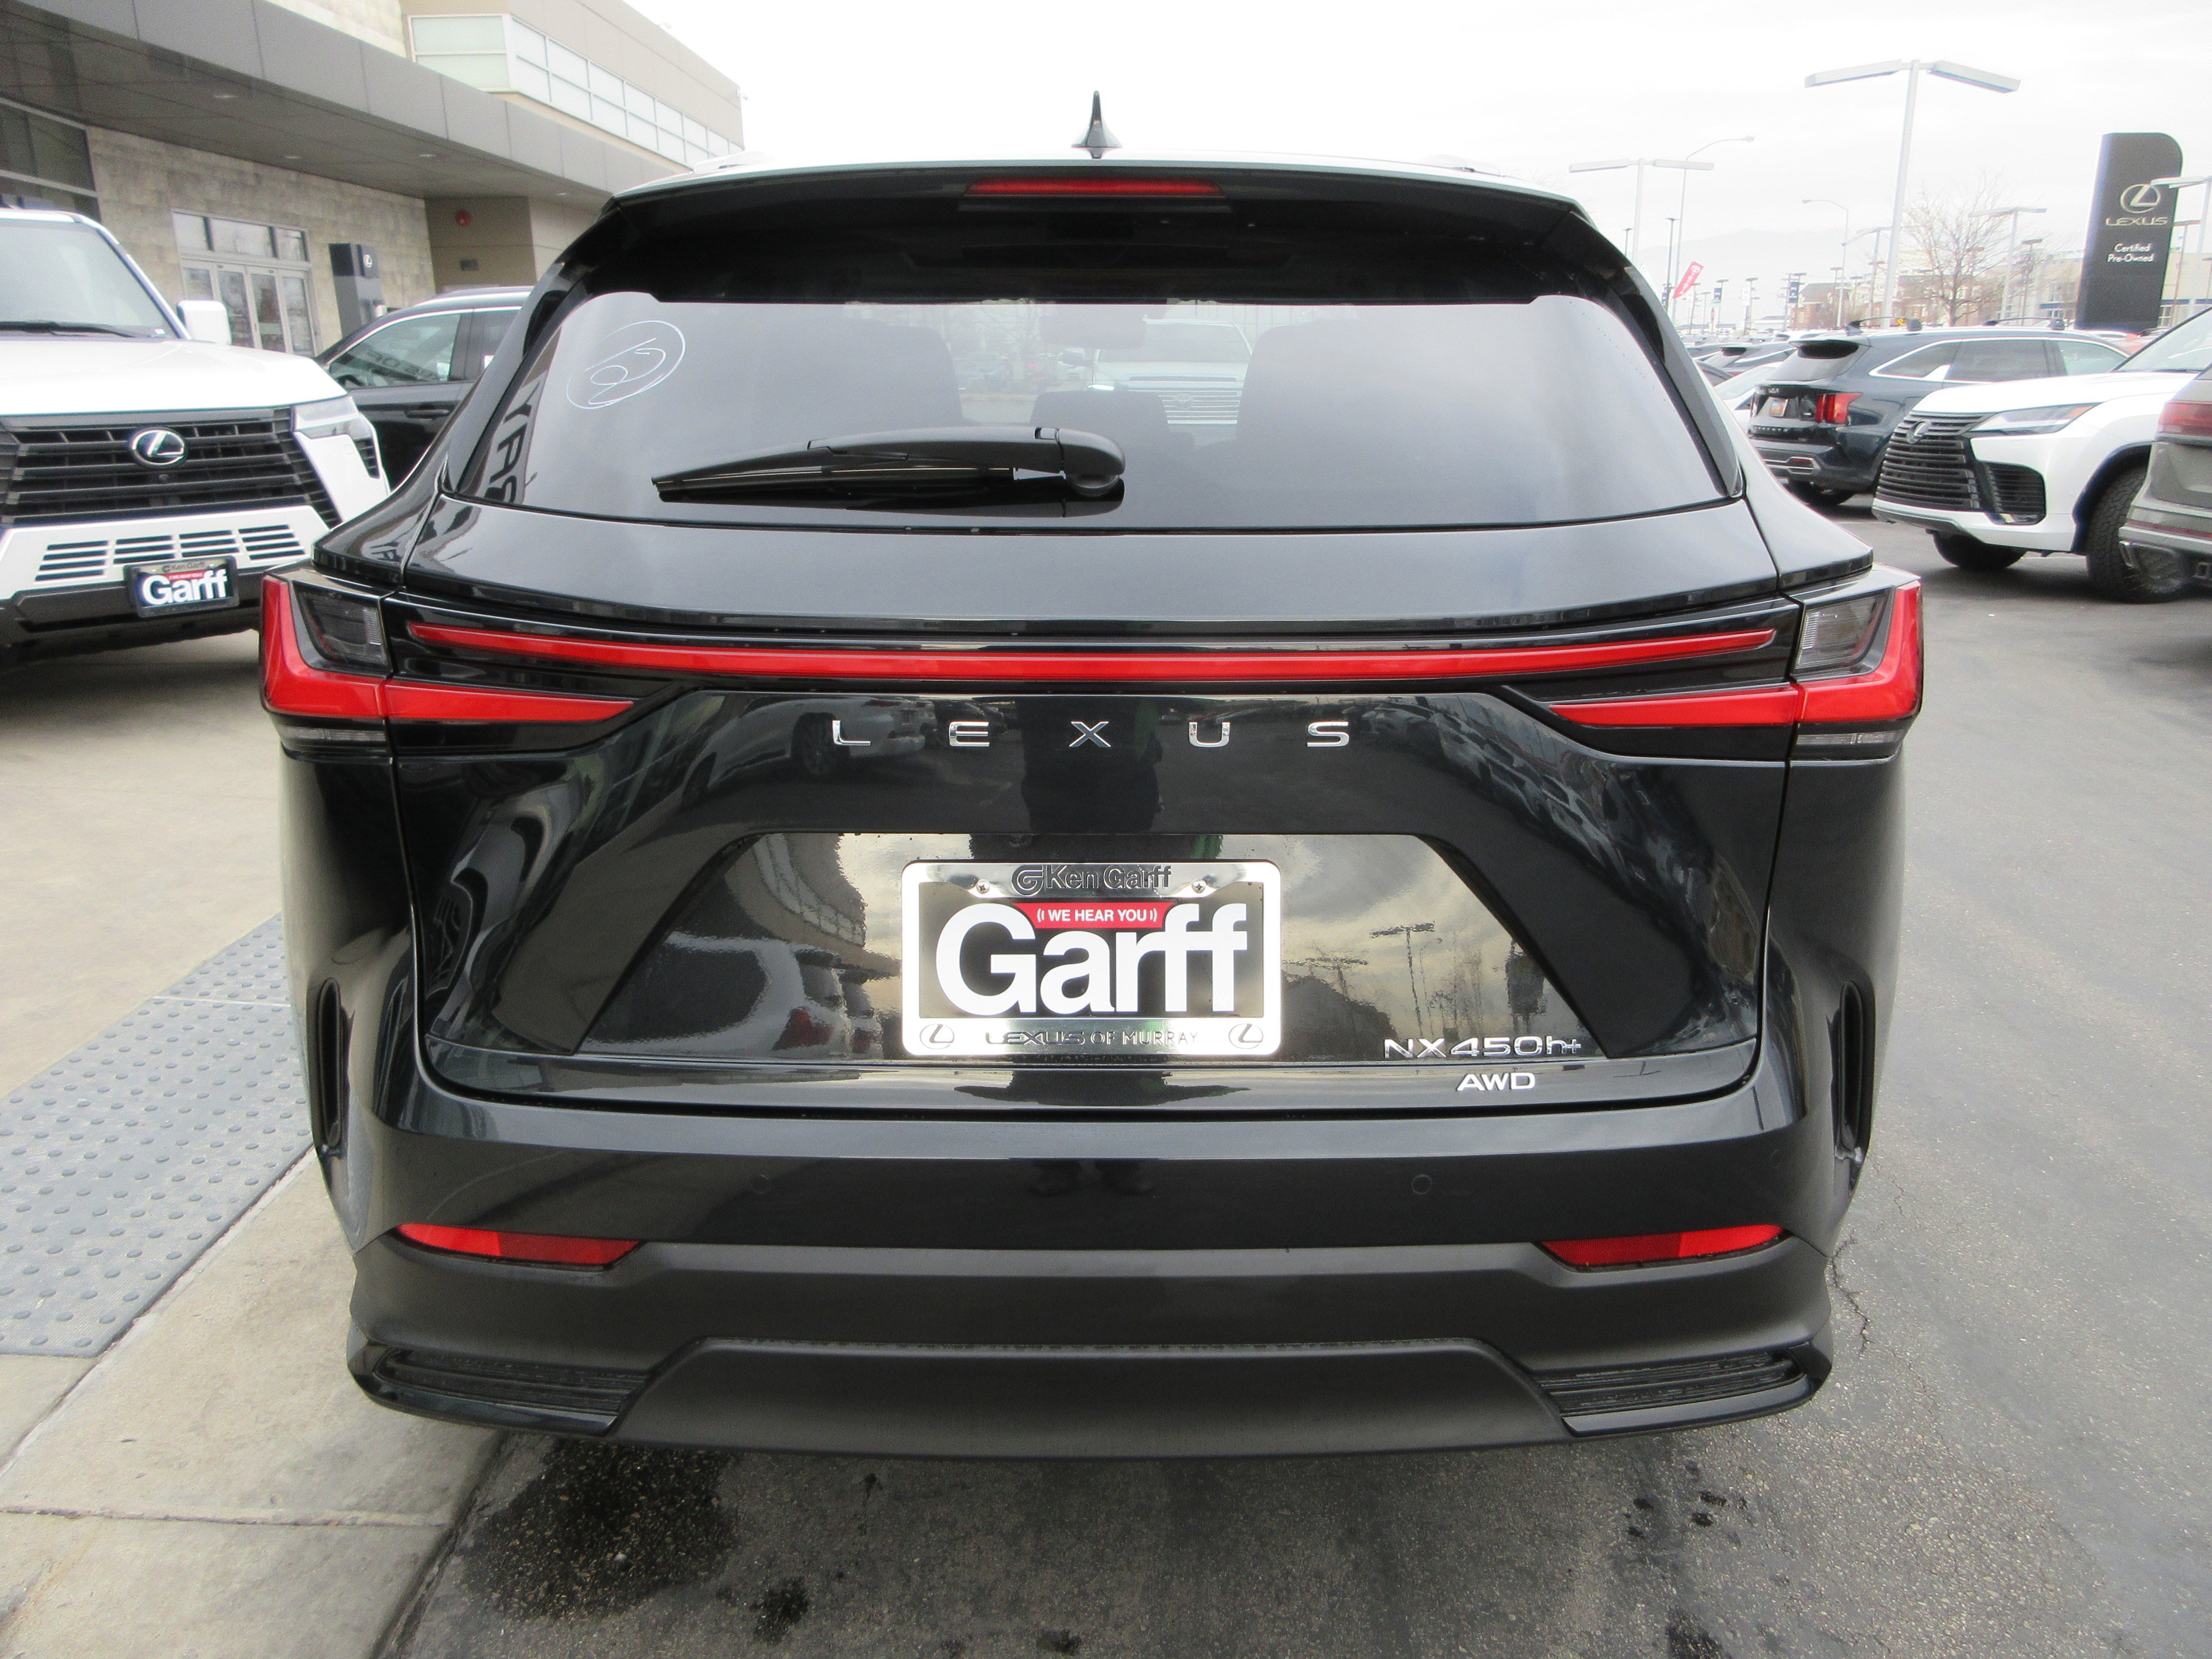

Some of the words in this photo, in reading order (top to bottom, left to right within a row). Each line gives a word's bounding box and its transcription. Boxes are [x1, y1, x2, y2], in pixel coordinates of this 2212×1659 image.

[2105, 216, 2169, 226] LEXUS
[2114, 243, 2152, 252] Certified
[2107, 253, 2155, 262] Pre-Owned
[142, 568, 228, 605] Garff
[832, 720, 1350, 748] LEXUS
[1046, 865, 1099, 889] Ken
[1104, 865, 1172, 890] Garff
[1048, 909, 1071, 921] WE
[1075, 909, 1114, 921] HEAR
[1117, 909, 1147, 922] YOU
[935, 903, 1247, 1016] Garff
[985, 1031, 1085, 1045] LEXUS
[1091, 1031, 1115, 1045] OF
[1122, 1031, 1198, 1045] MURRAY
[1384, 1036, 1581, 1059] NX450h+
[1456, 1072, 1536, 1091] AWD
